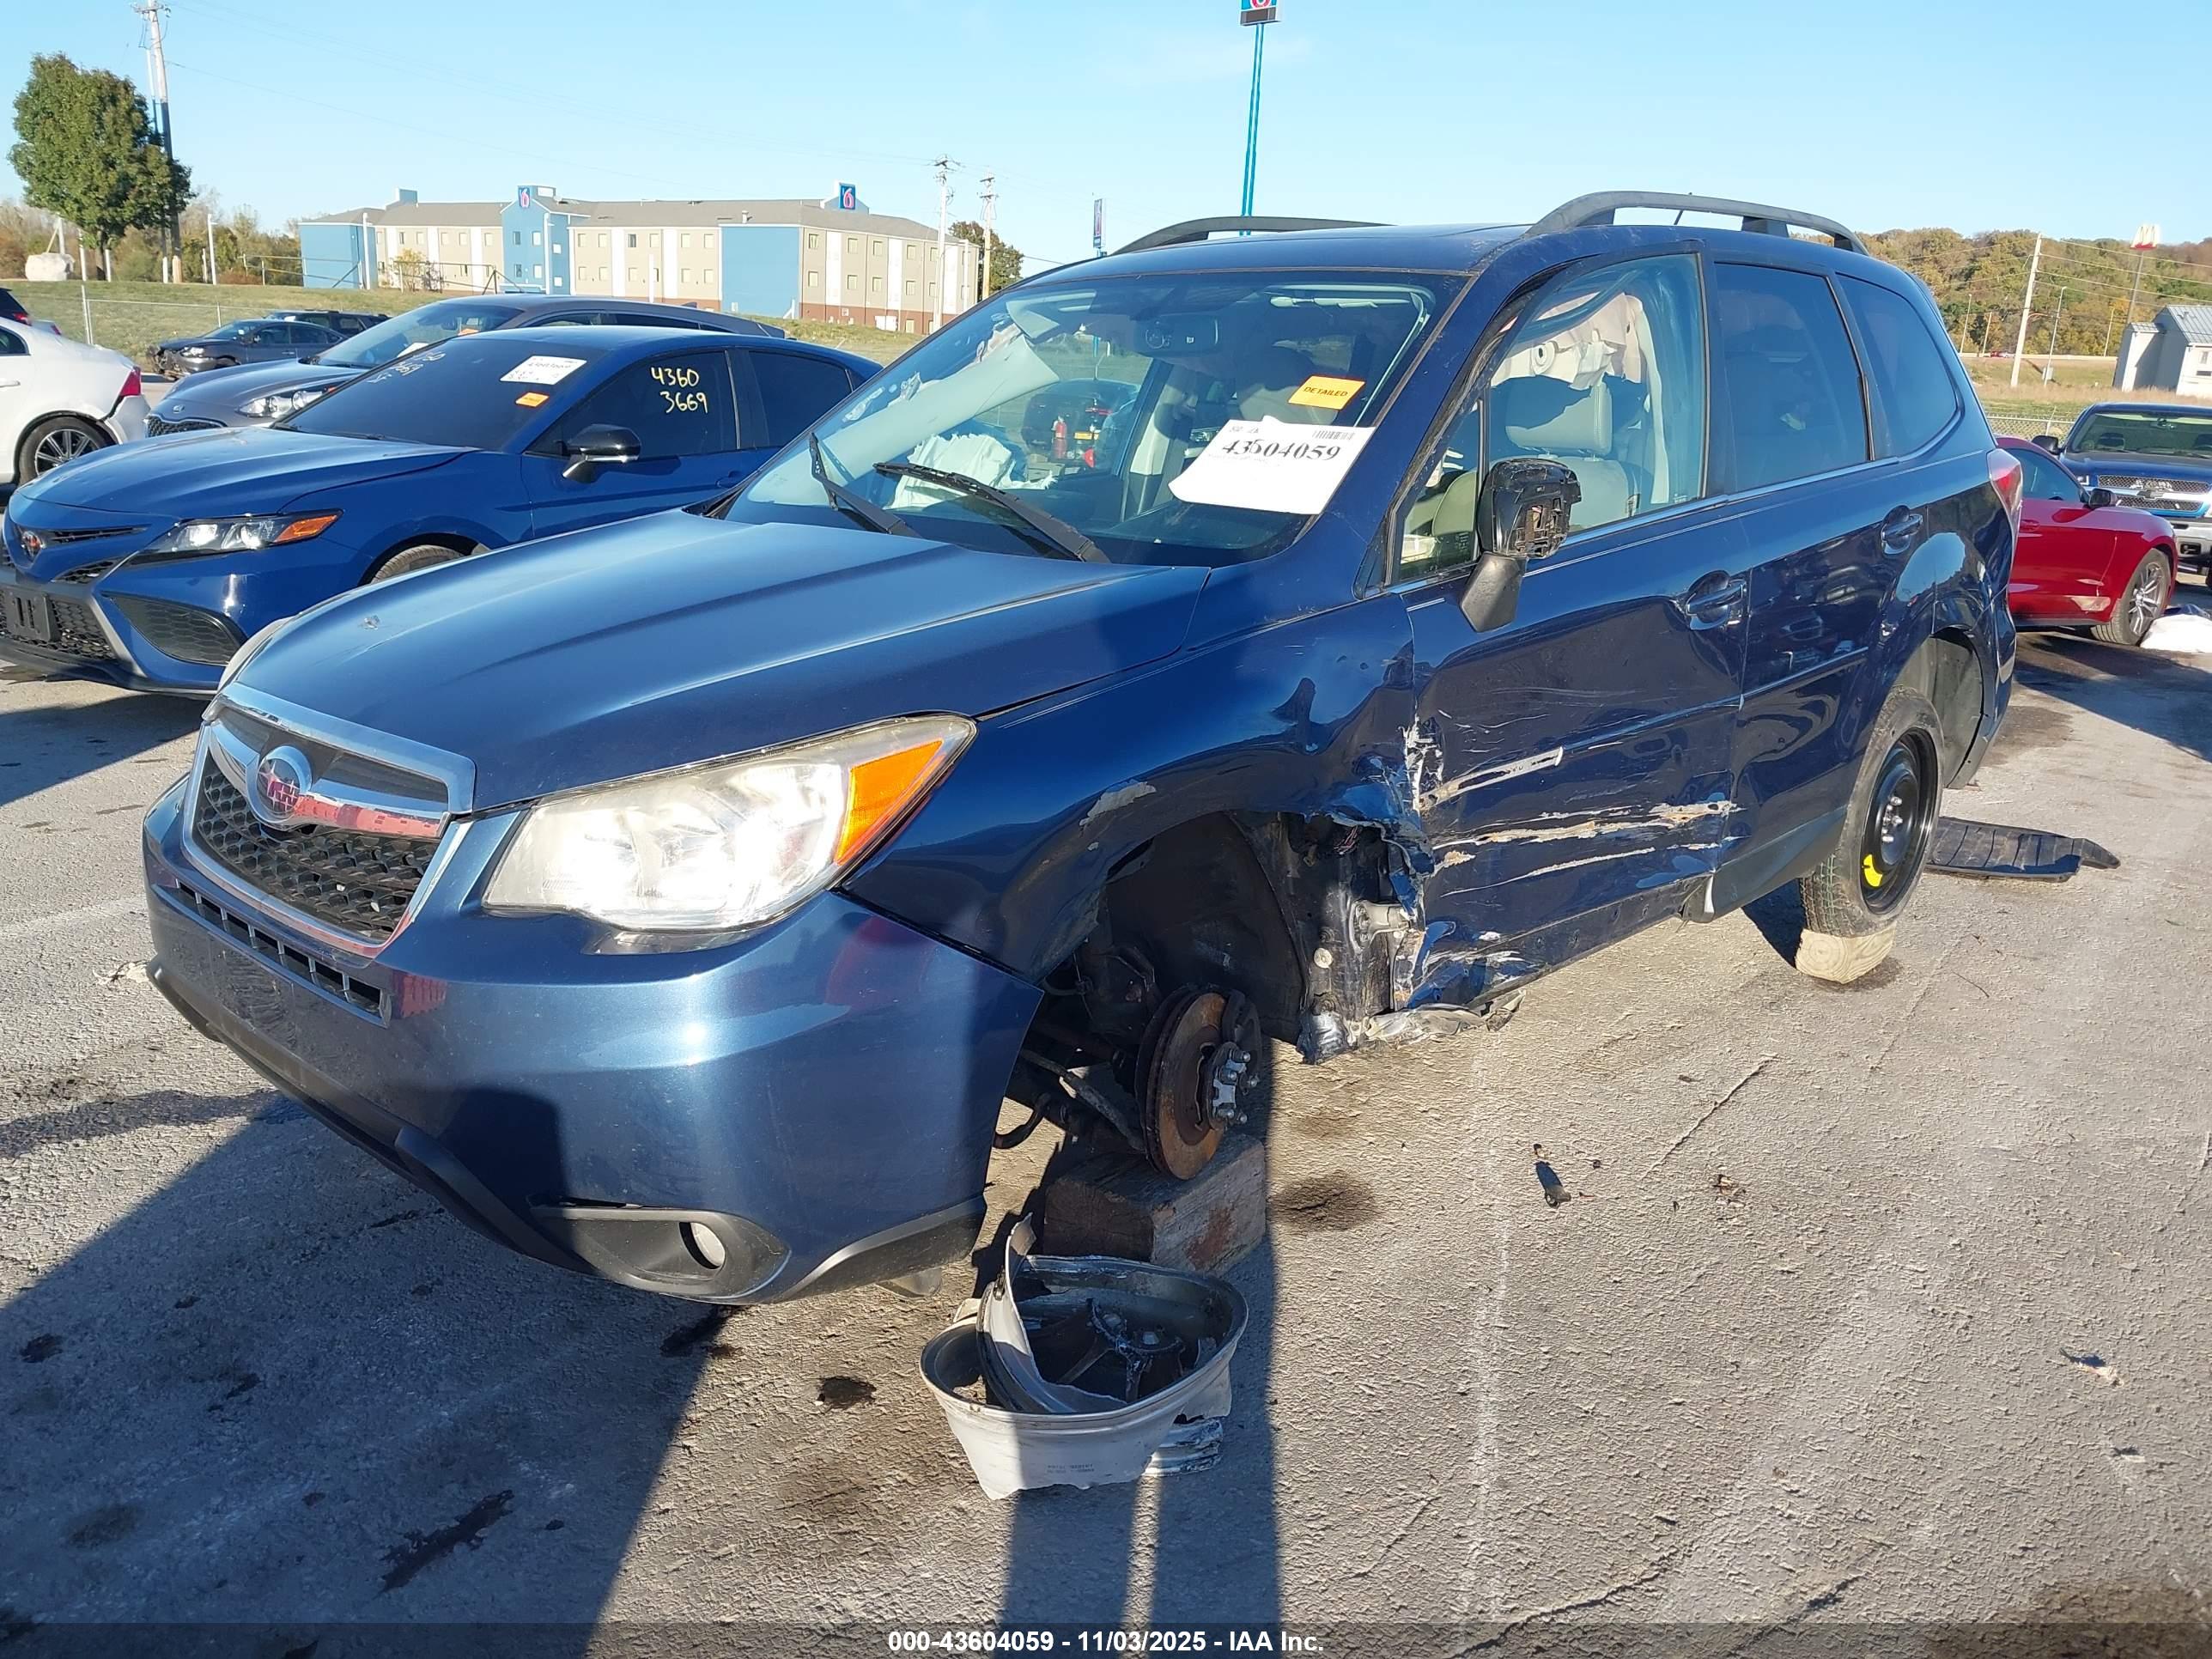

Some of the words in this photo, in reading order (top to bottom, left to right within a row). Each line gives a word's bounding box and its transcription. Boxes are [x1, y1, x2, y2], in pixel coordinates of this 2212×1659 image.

[843, 187, 854, 209] 6
[650, 367, 700, 387] 4360
[659, 391, 708, 413] 3669
[1304, 386, 1348, 397] DETAILED
